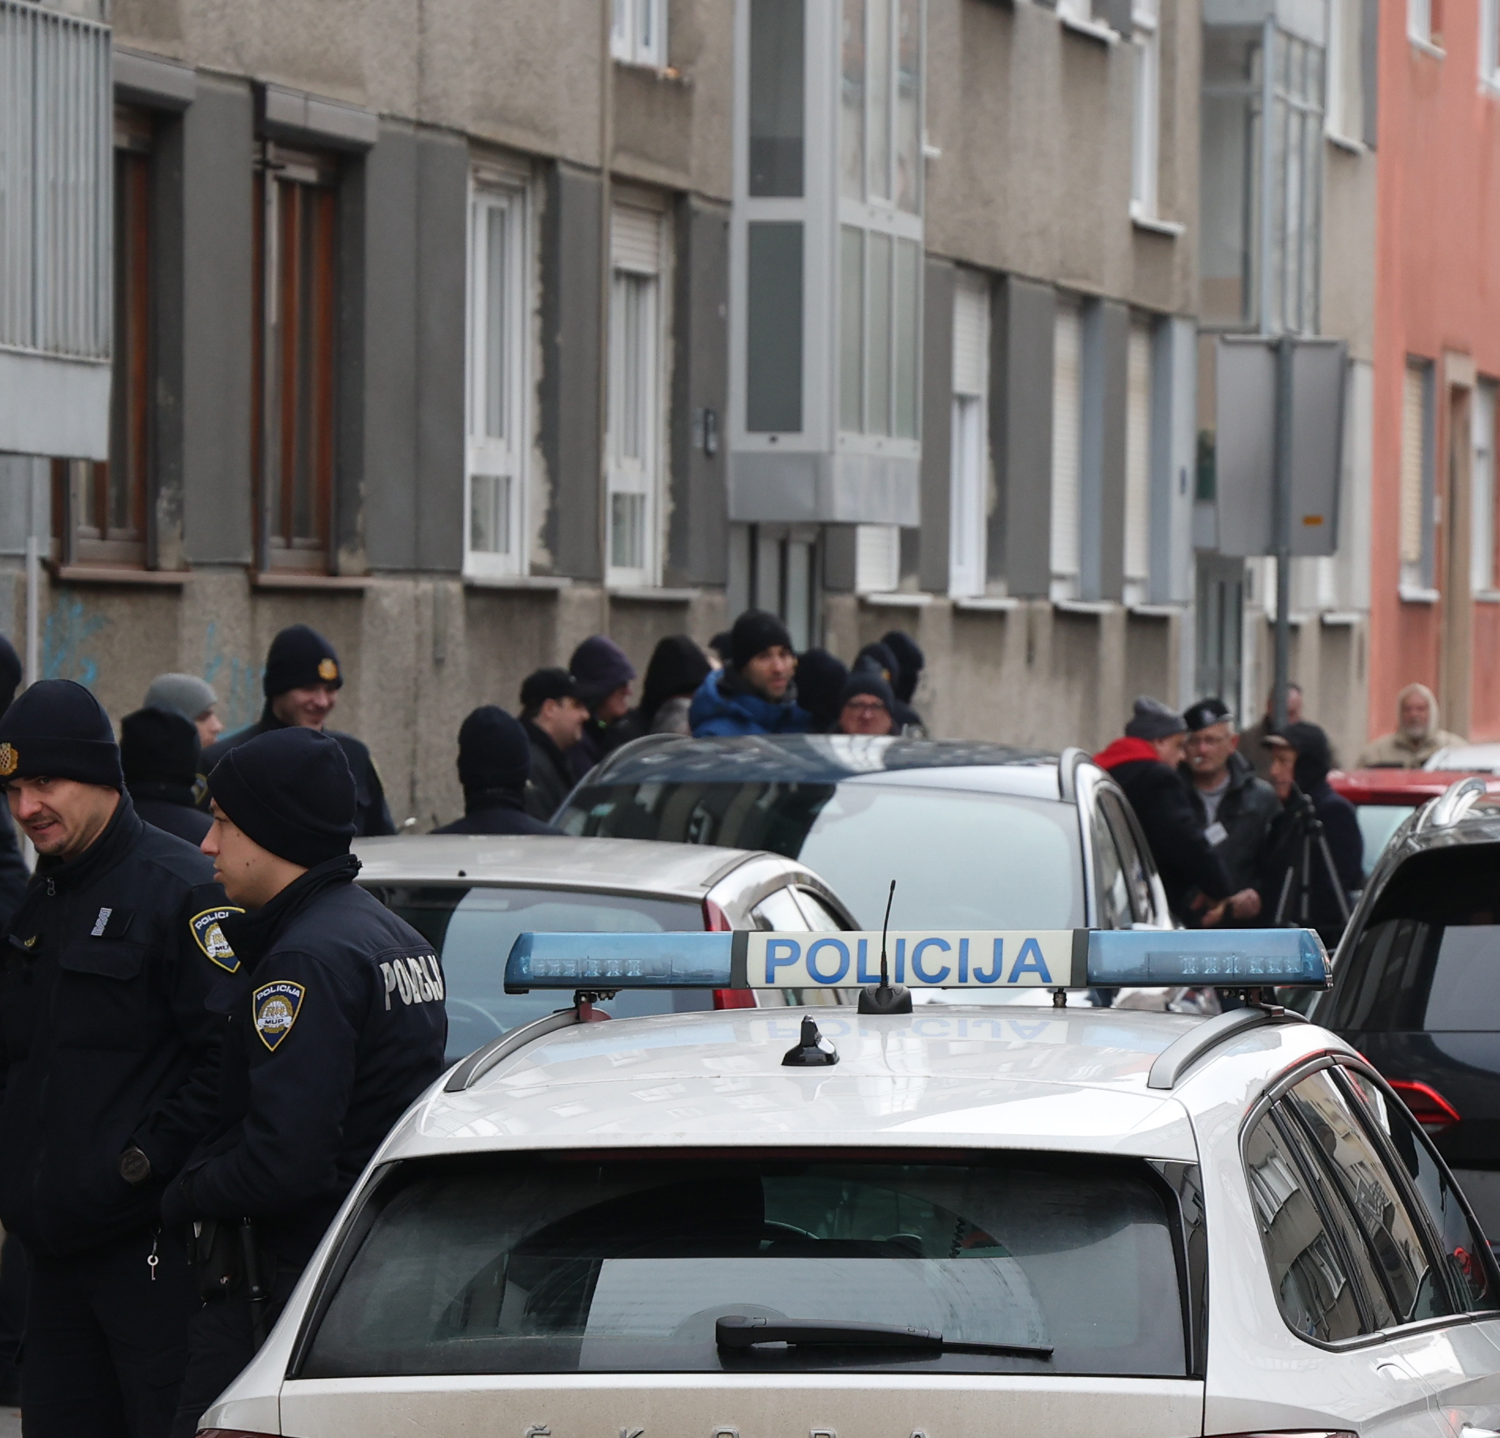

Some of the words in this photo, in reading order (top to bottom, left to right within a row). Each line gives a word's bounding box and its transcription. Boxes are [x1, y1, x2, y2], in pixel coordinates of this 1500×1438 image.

[194, 911, 230, 930] POLICI
[764, 937, 1053, 985] POLICIJA
[256, 984, 301, 1000] POLICIJA
[379, 954, 444, 1011] POLICIJ
